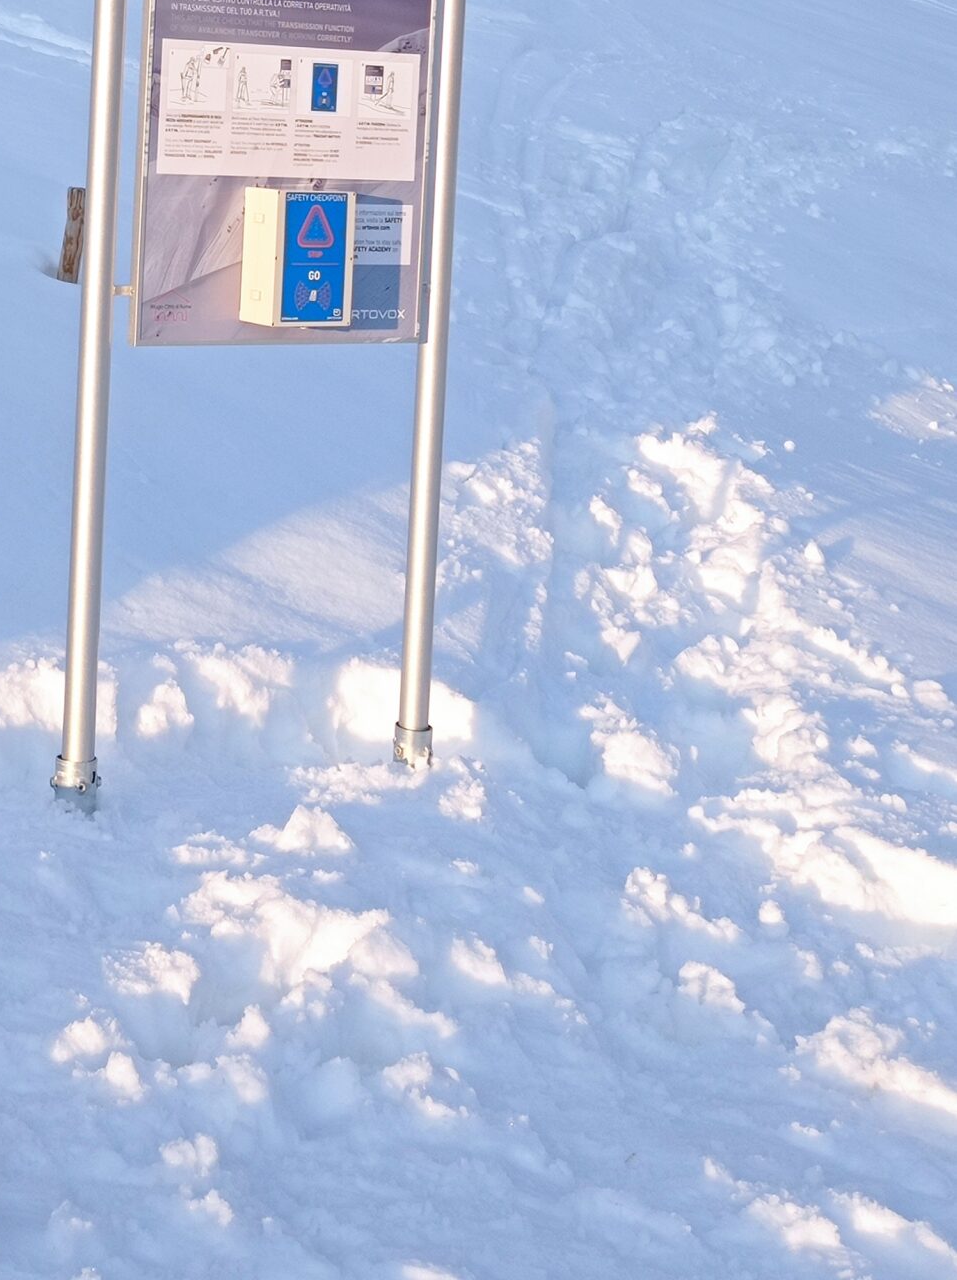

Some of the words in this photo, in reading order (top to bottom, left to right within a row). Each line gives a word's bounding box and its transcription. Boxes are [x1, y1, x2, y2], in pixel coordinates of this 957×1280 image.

[179, 3, 225, 14] TRASMISSIONE
[226, 7, 238, 15] DEL
[239, 7, 252, 16] TUO
[274, 0, 282, 7] LA
[283, 0, 314, 9] CORRETTA
[314, 2, 352, 12] OPERATIVITÀ
[278, 21, 323, 31] TRANSMISSION
[324, 24, 354, 33] FUNCTION
[287, 193, 309, 202] SAFETY
[310, 194, 346, 202] CHECKPOINT
[308, 270, 321, 281] GO
[352, 309, 405, 320] RTOVOX
